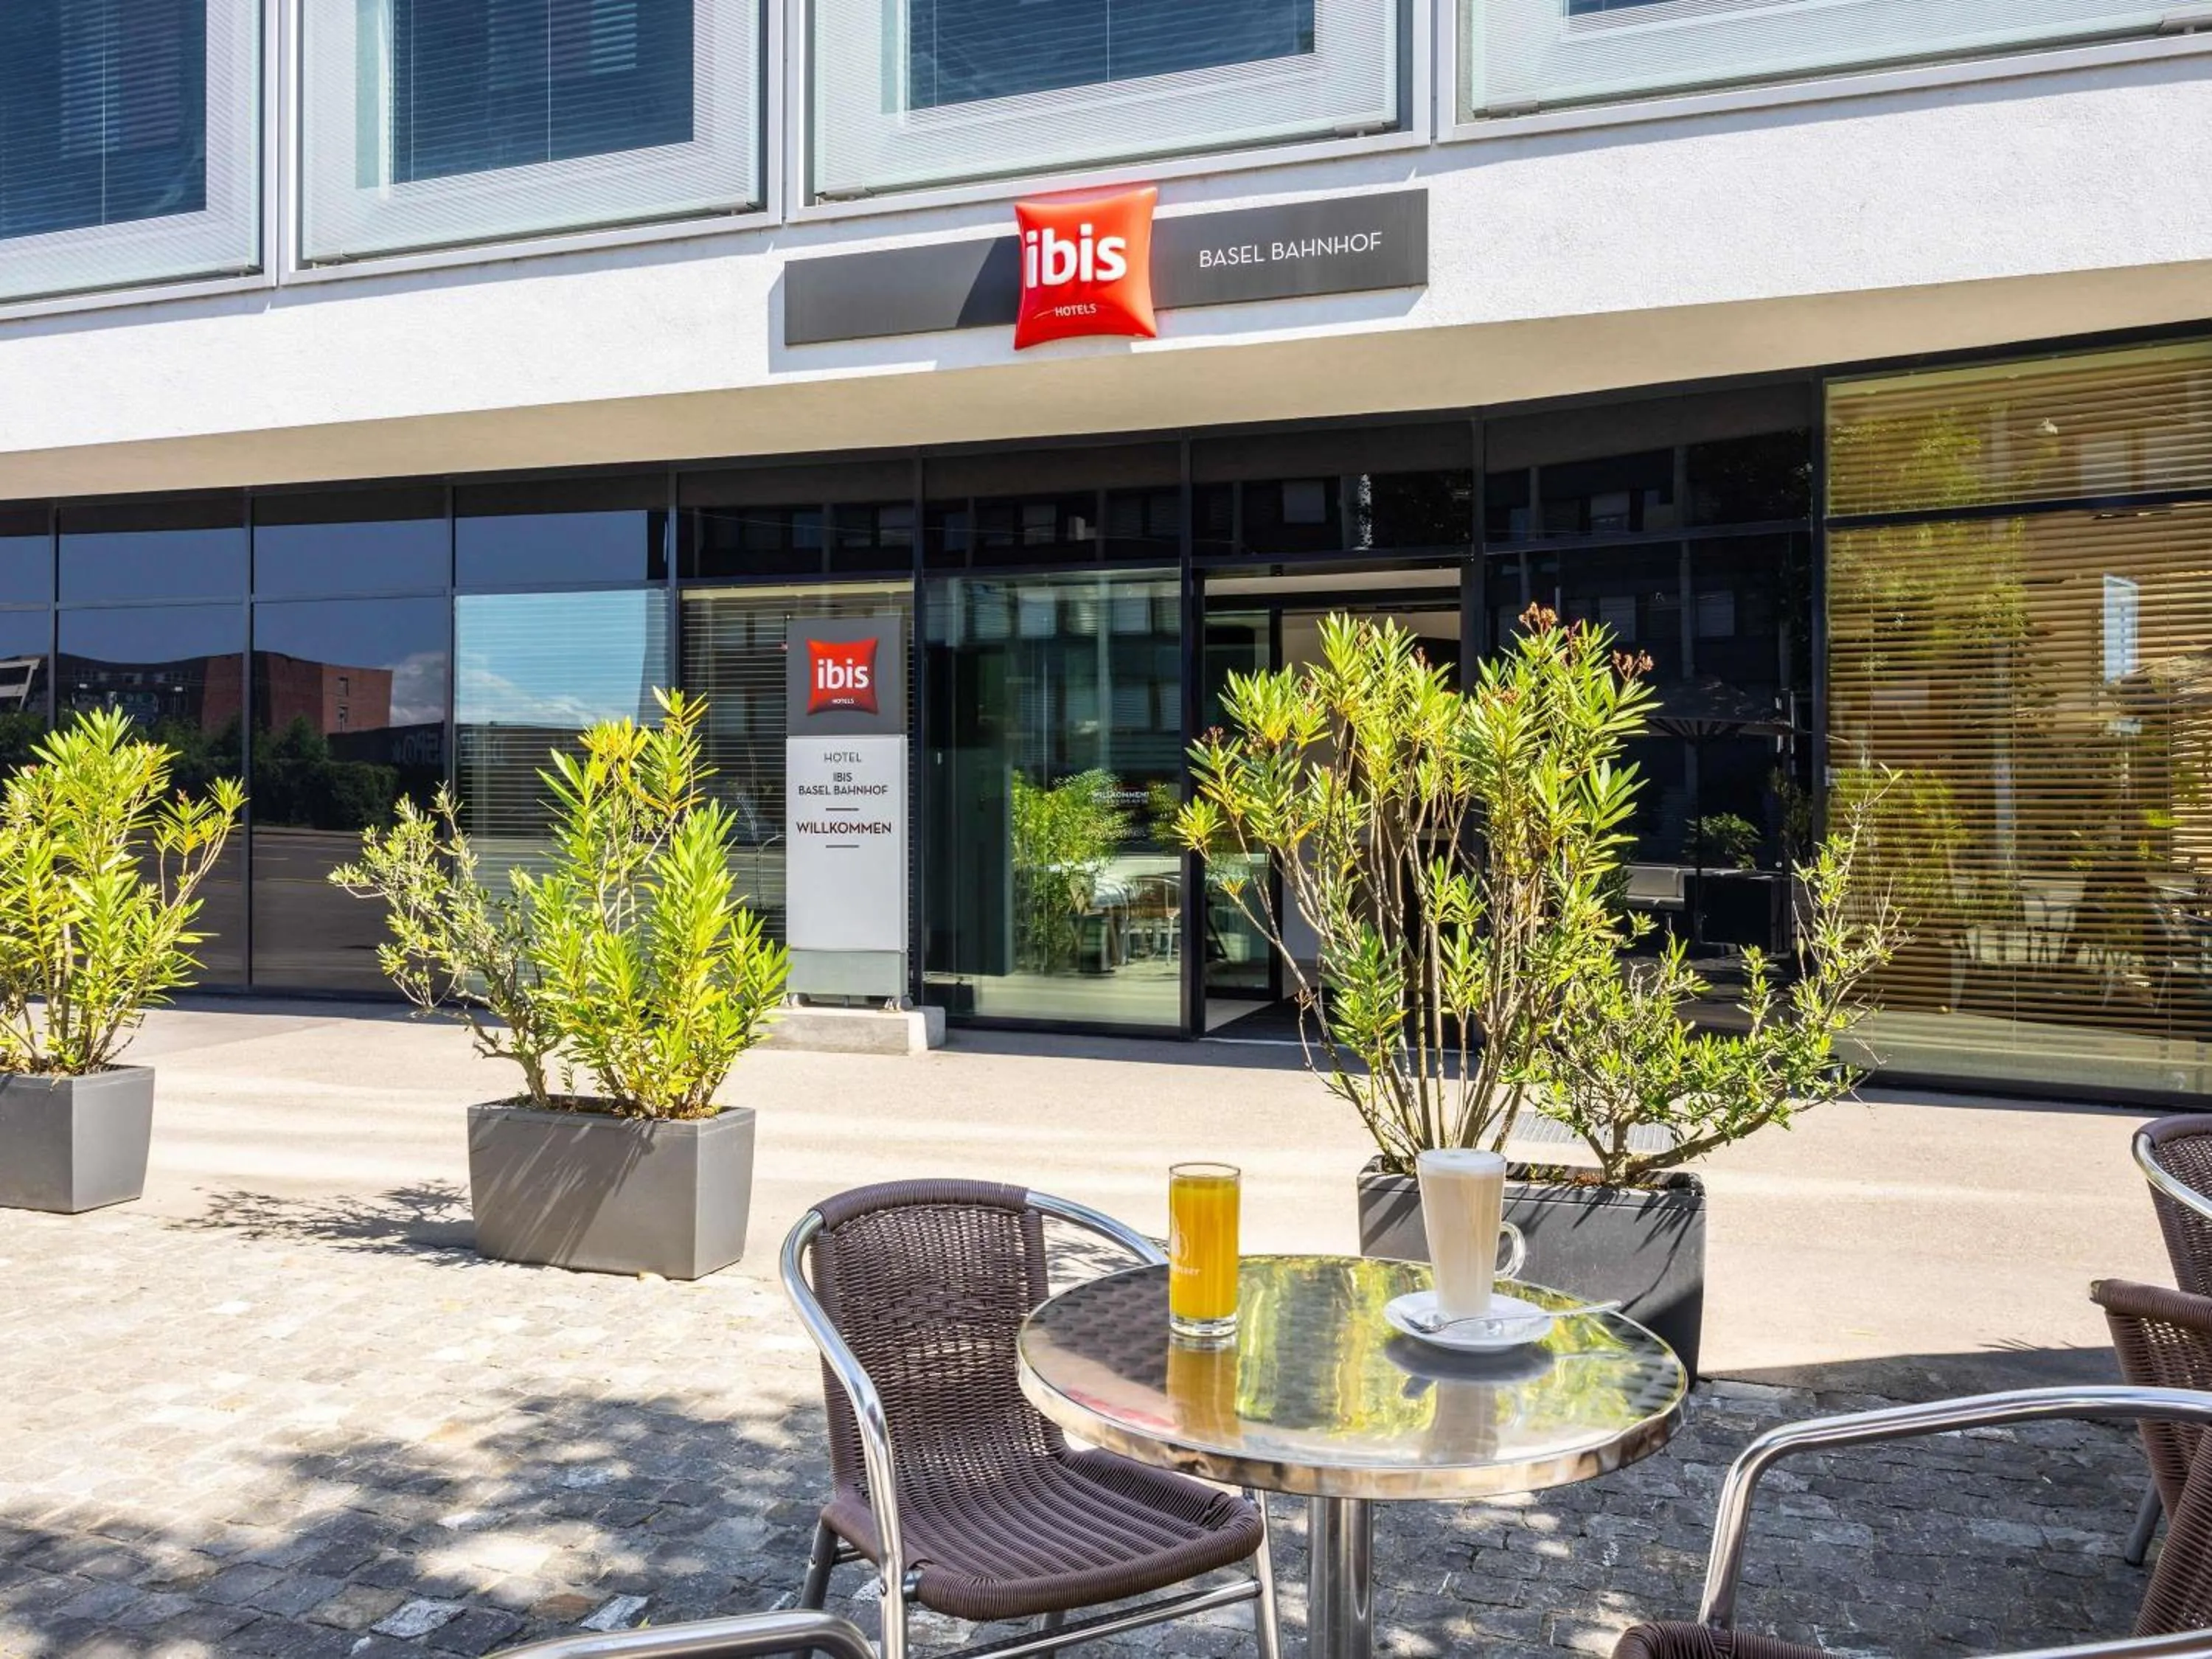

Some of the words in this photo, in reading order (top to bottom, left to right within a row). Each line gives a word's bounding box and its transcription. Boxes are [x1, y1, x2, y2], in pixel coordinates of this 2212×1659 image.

[1026, 223, 1127, 288] ibis
[1199, 245, 1265, 268] BASEL
[1272, 232, 1382, 260] BAHNHOF
[1055, 303, 1097, 317] HOTELS
[817, 659, 869, 689] ibis
[824, 752, 862, 762] HOTEL
[832, 772, 853, 782] IBIS
[799, 785, 831, 796] BASEL
[834, 785, 888, 796] BAHNHOF
[796, 822, 891, 835] WILLKOMMEN
